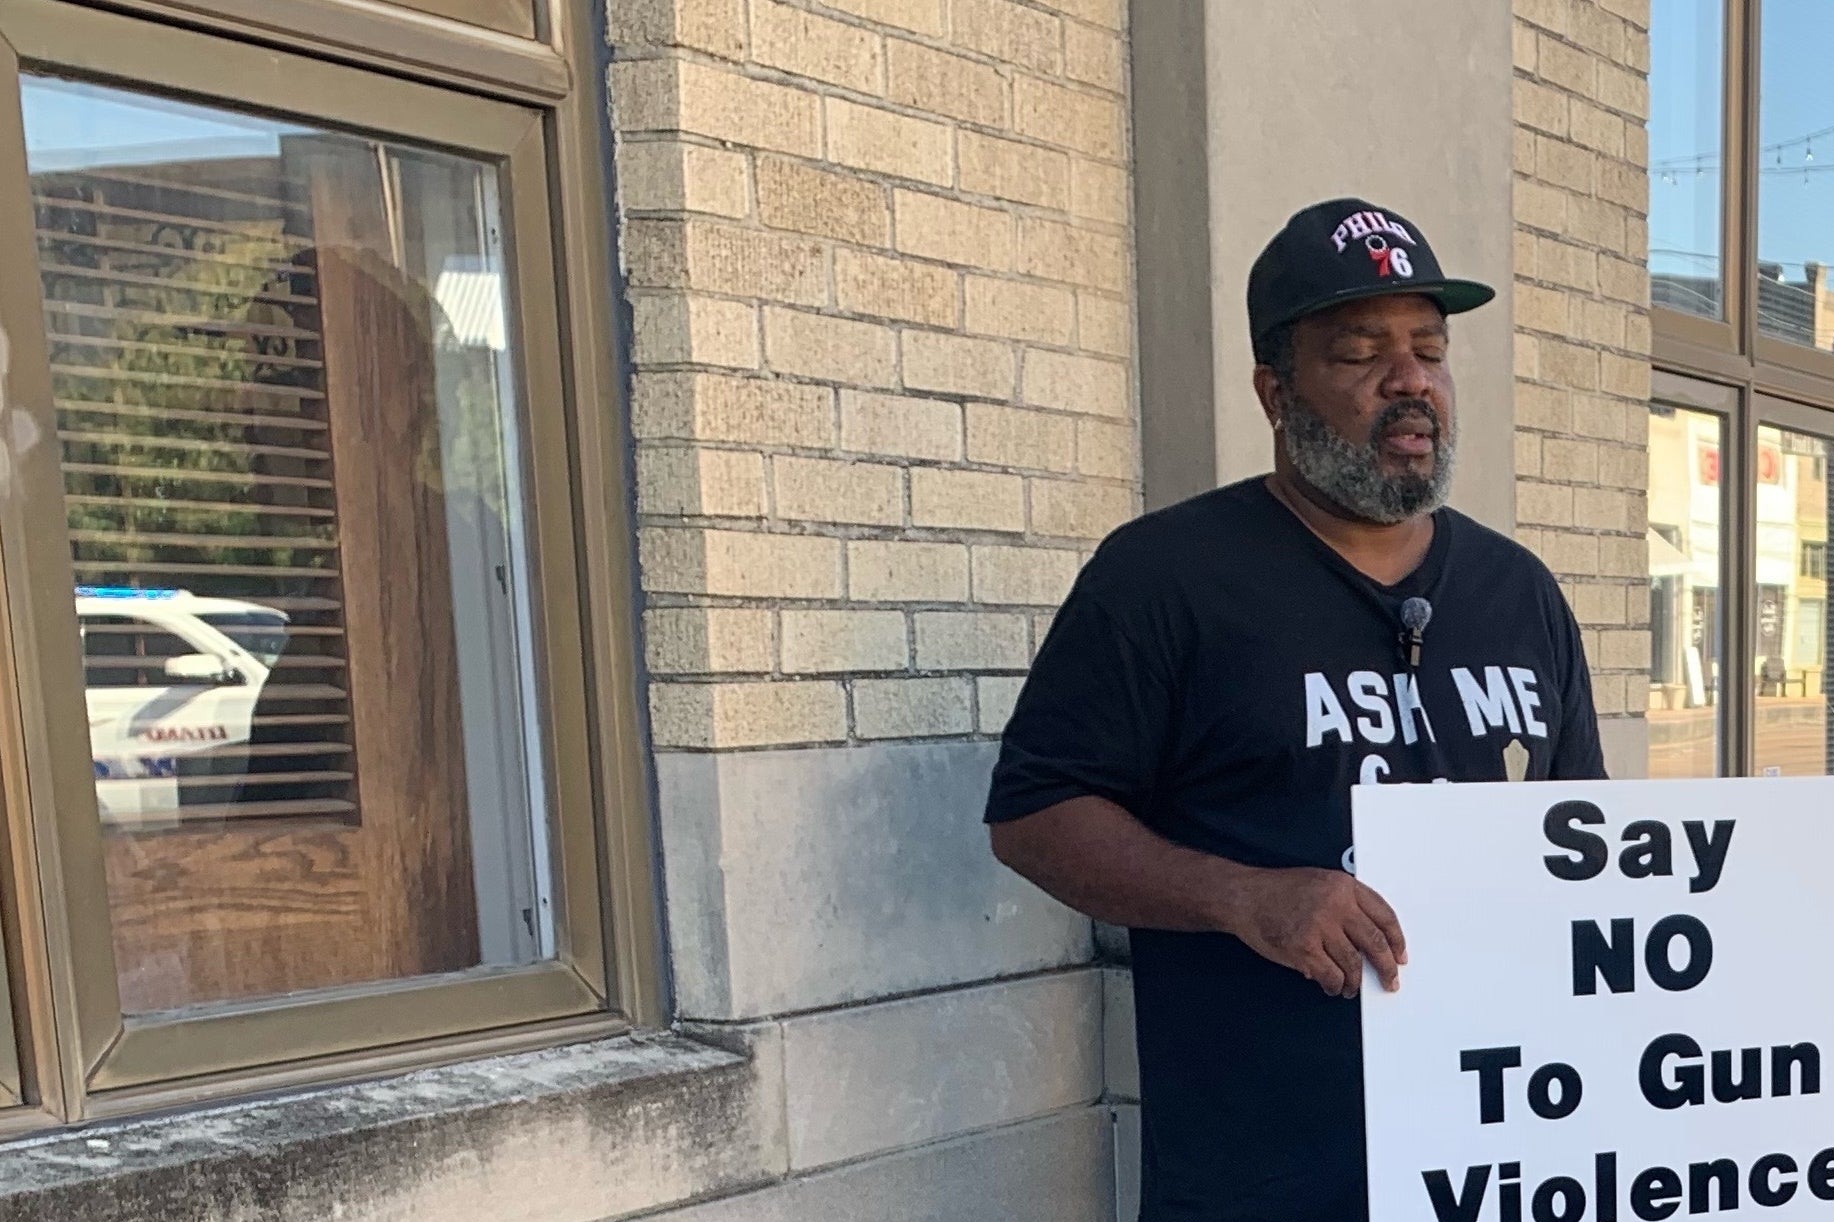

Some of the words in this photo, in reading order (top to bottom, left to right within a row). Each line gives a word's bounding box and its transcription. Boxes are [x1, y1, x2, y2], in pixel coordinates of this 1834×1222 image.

[1330, 211, 1417, 253] PHILA
[1368, 247, 1414, 279] 76
[1304, 670, 1436, 748] ASK
[1450, 665, 1548, 739] ME
[1543, 800, 1736, 894] Say
[1571, 914, 1713, 997] NO
[1459, 1045, 1583, 1125] To
[1638, 1033, 1821, 1110] Gun
